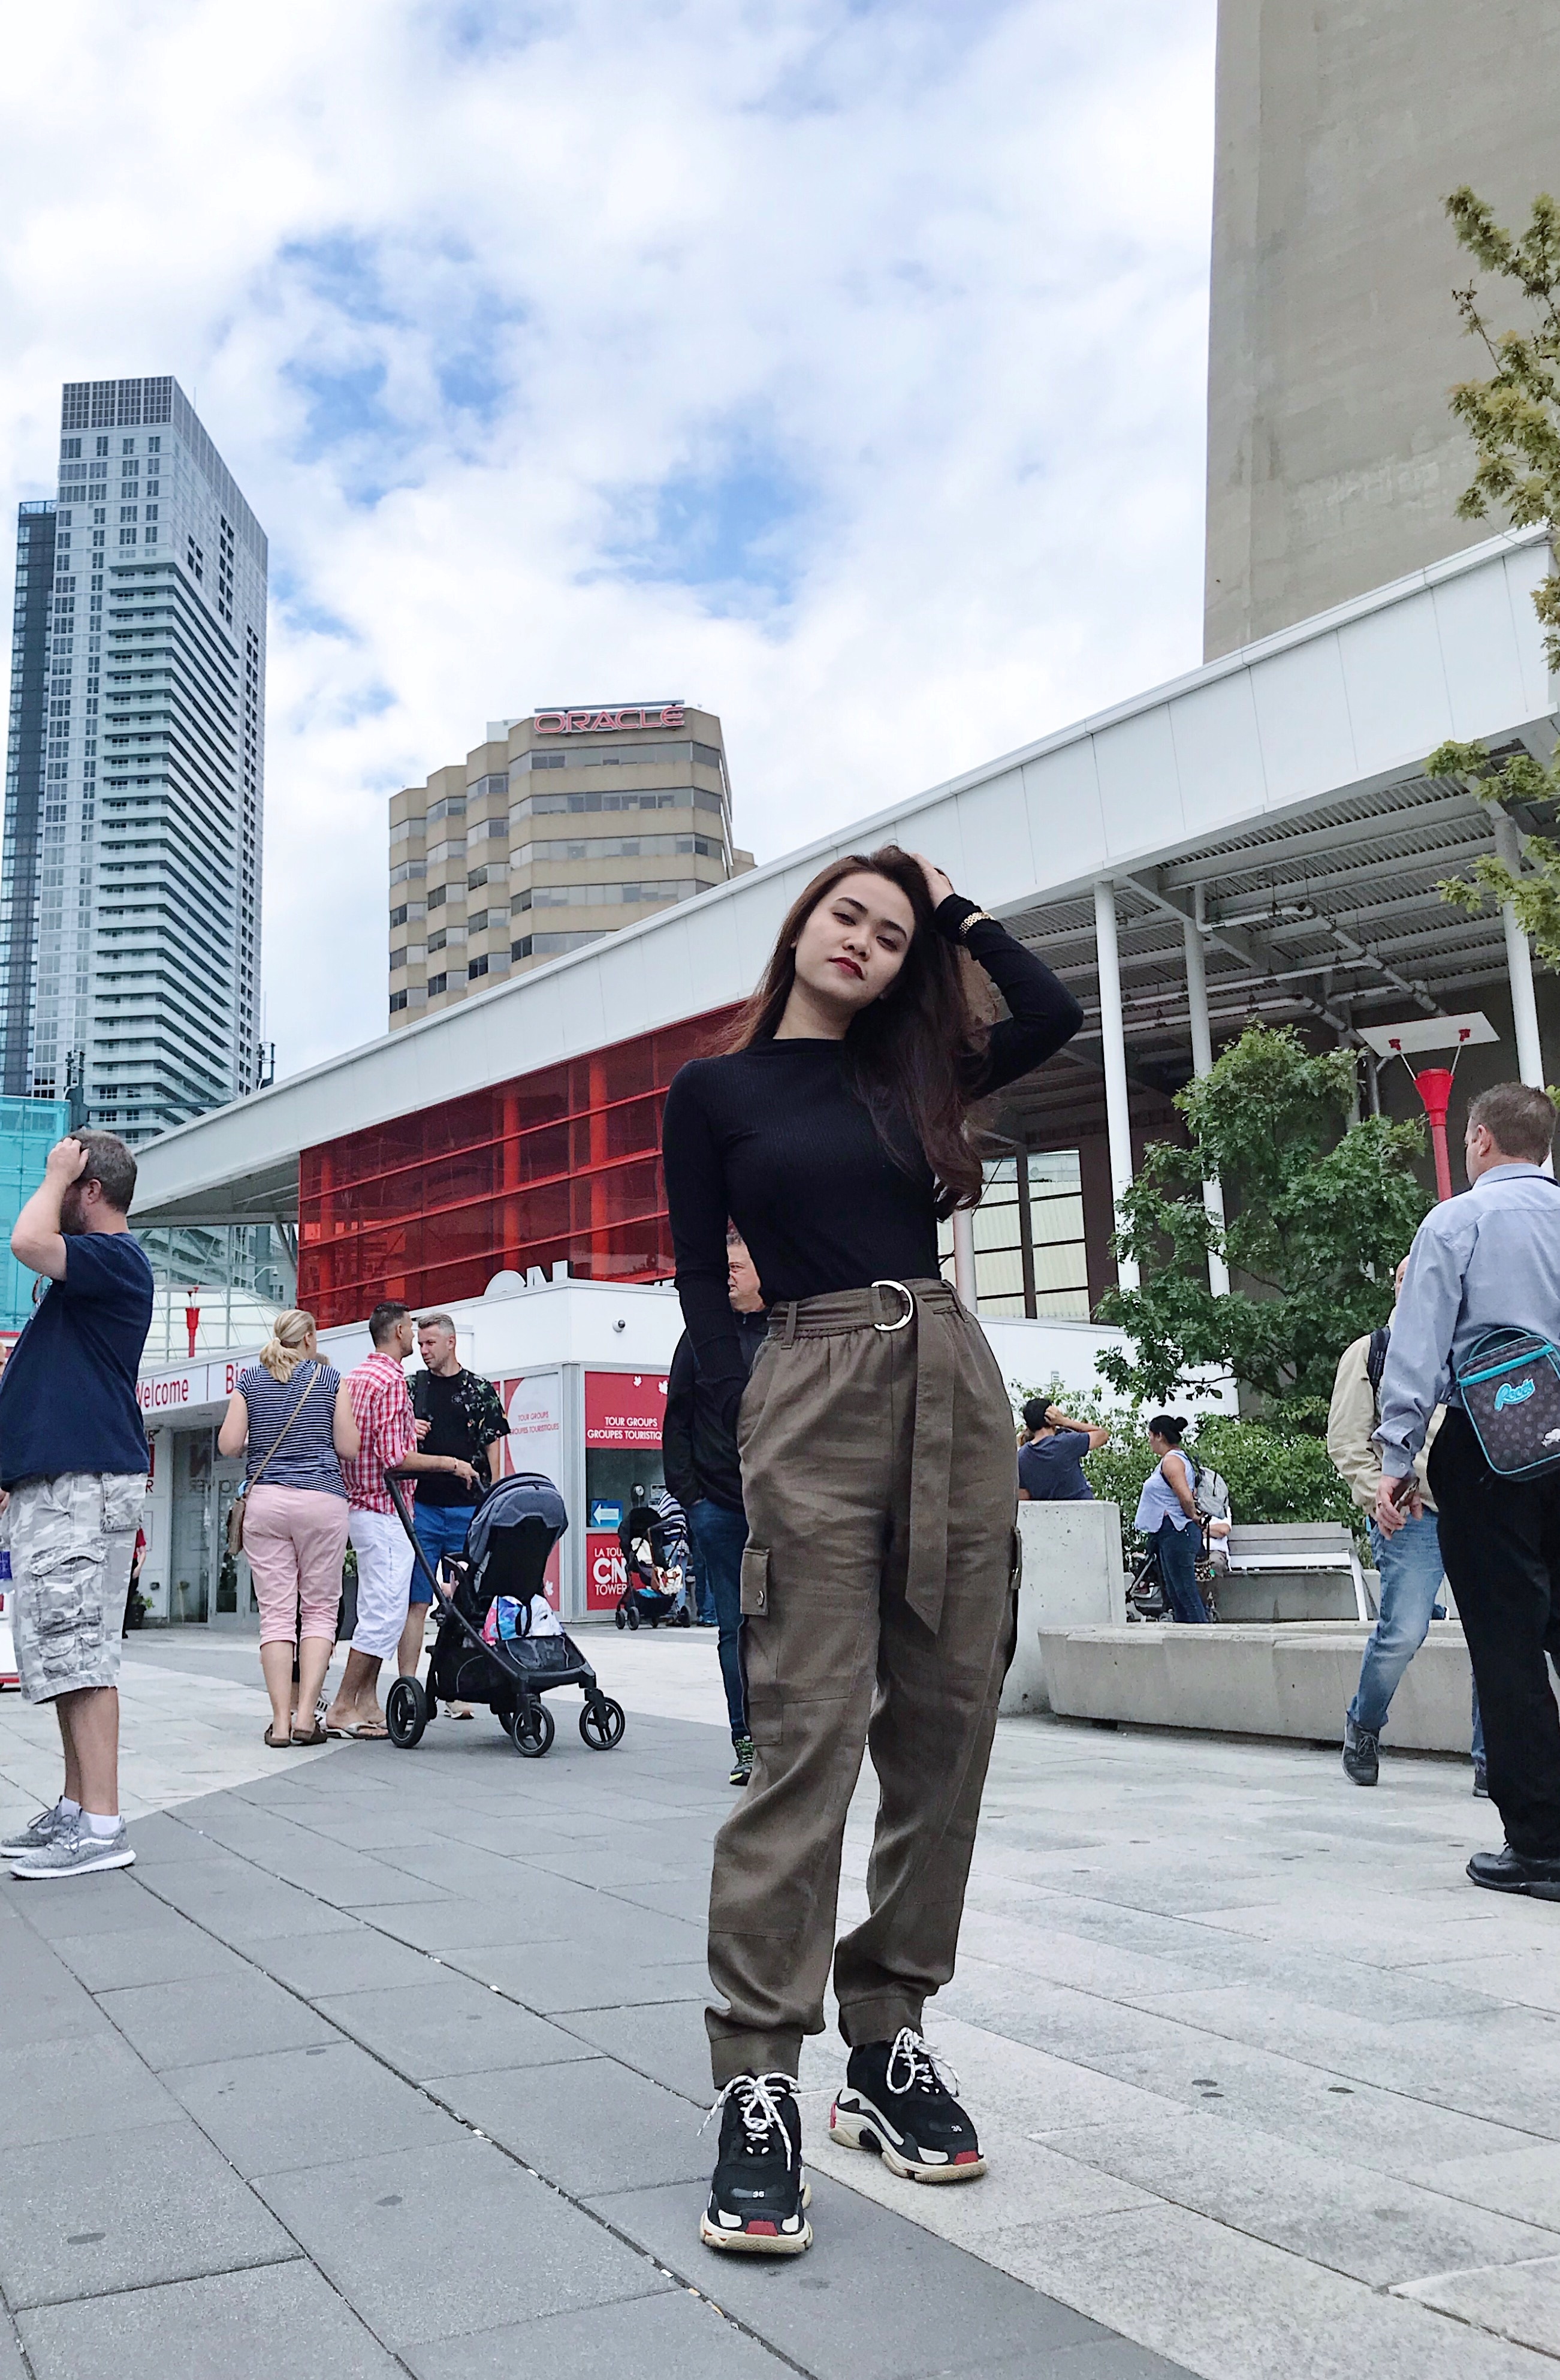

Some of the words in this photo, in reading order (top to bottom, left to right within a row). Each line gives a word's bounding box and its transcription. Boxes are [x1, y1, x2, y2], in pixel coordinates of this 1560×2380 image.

[533, 706, 686, 734] ORACLE
[1494, 1378, 1535, 1412] Roots
[530, 1411, 549, 1420] GROUPS
[604, 1416, 625, 1426] TOUR
[626, 1417, 658, 1427] GROUPS
[529, 1423, 559, 1433] TOURISTIQUES
[587, 1429, 623, 1439] GROUPES
[624, 1430, 663, 1441] TOURISTIQ
[595, 1548, 605, 1557] LA
[607, 1547, 624, 1557] TOU
[593, 1557, 627, 1584] CN
[595, 1584, 627, 1596] TOWER
